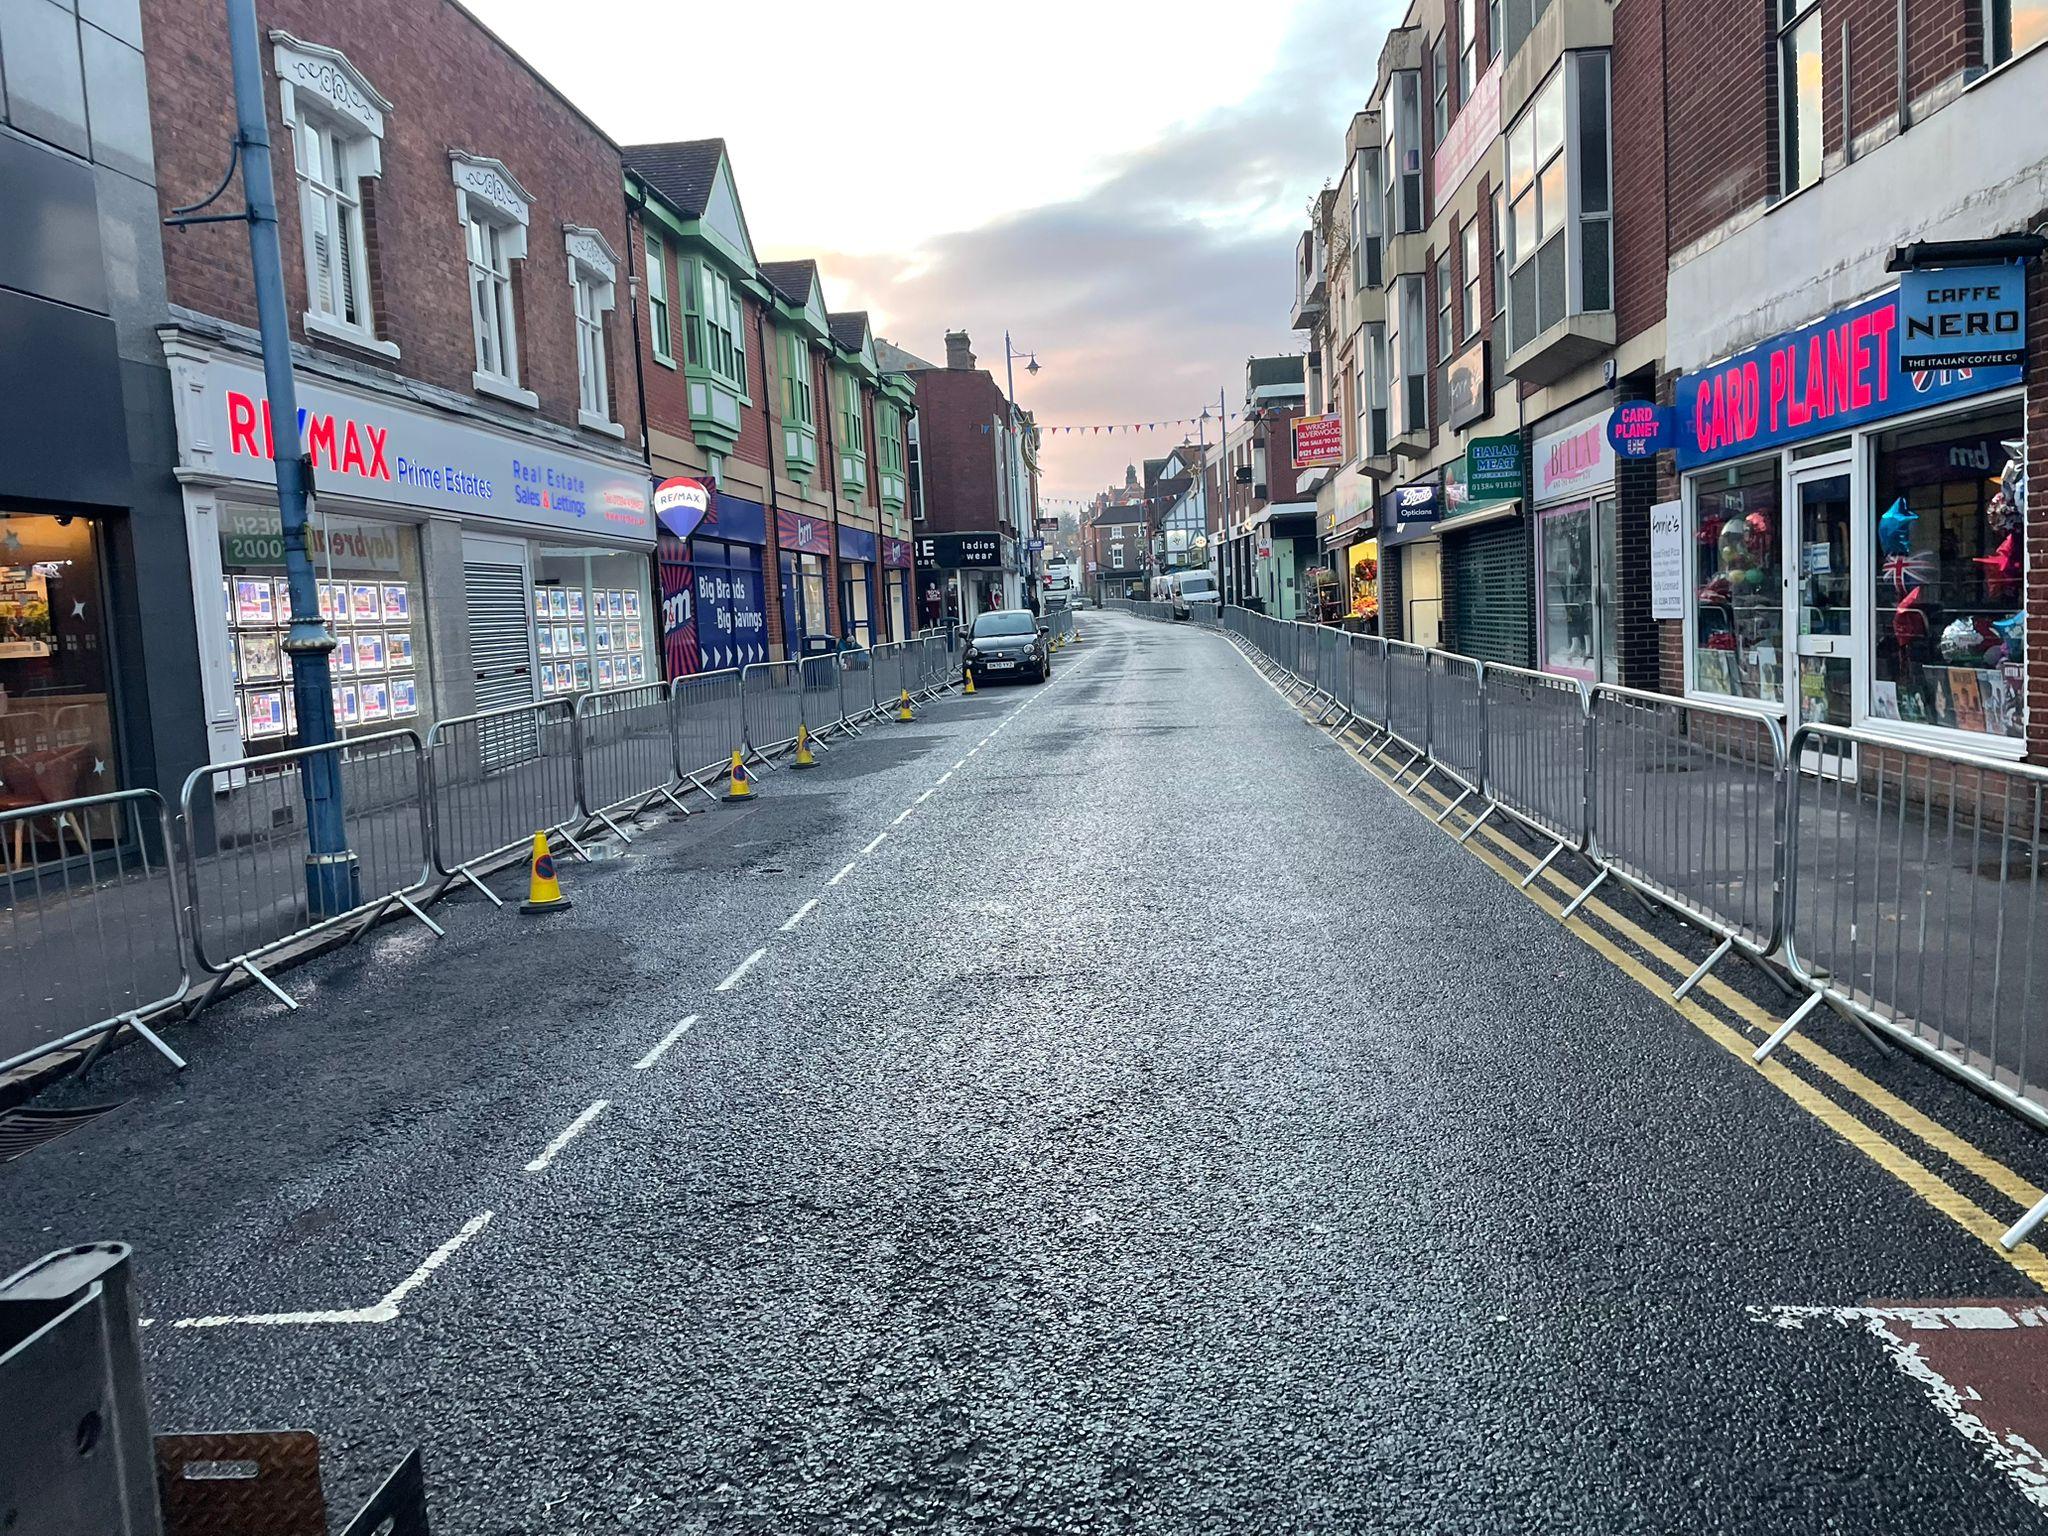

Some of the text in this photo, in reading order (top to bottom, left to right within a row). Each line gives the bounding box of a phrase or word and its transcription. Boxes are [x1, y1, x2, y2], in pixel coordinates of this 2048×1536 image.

[1927, 285, 2001, 304] CAFFE
[1906, 310, 2019, 340] NERO
[1908, 359, 1926, 367] THE
[1928, 356, 1965, 366] ITALIAN
[1696, 303, 1896, 454] CARD PLANET
[1621, 407, 1653, 423] CARD
[1305, 421, 1335, 431] WRIGHT
[1615, 422, 1660, 439] PLANET
[1472, 444, 1520, 458] HALAL
[1627, 439, 1647, 455] UK
[1477, 458, 1515, 471] MEAT
[396, 456, 492, 500] Prime Estates
[513, 460, 585, 494] Real Estate
[514, 484, 541, 507] Sales
[542, 489, 550, 510] &
[551, 492, 586, 518] Lettings
[661, 493, 701, 505] RE/MAX
[1401, 487, 1433, 506] Boots
[1401, 508, 1432, 518] Opticians
[962, 541, 996, 550] ladies
[699, 575, 715, 605] Big
[716, 606, 762, 635] Big Savings
